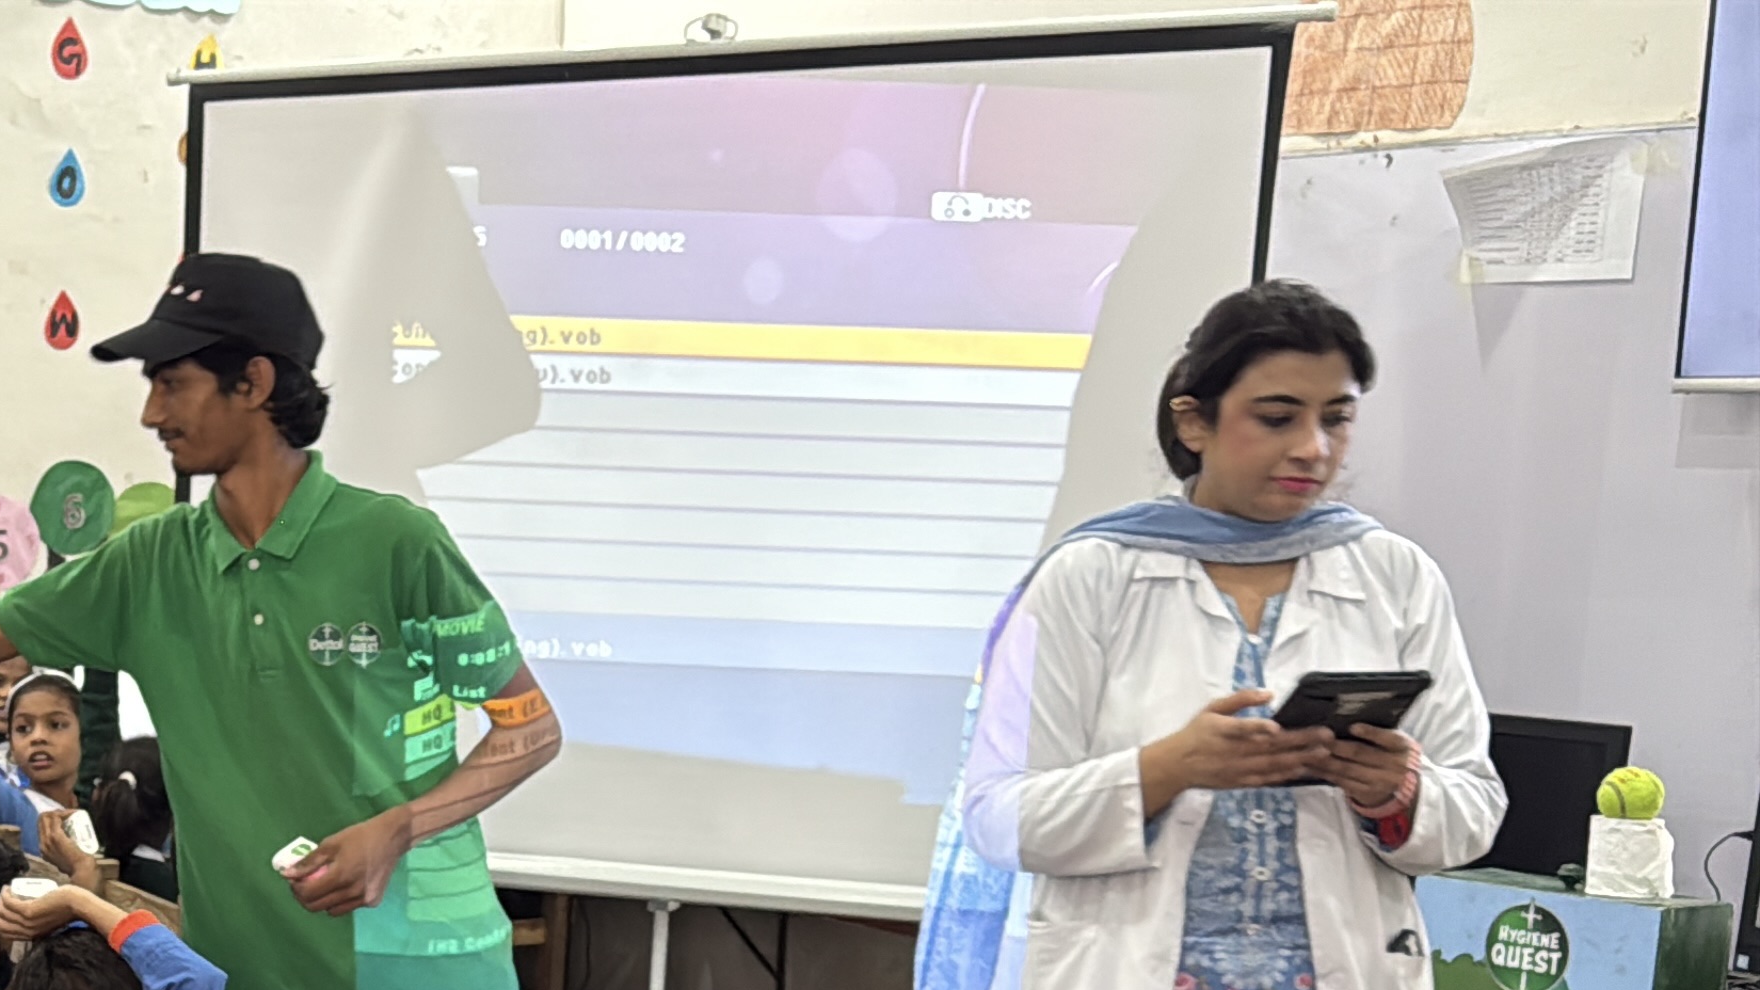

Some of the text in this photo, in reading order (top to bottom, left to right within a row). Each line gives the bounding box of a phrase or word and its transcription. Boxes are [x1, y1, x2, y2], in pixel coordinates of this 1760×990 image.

[57, 37, 82, 76] G
[982, 196, 1032, 220] DISC
[559, 229, 686, 252] 0001/0002
[48, 309, 76, 341] W
[64, 493, 87, 529] 6
[1498, 924, 1561, 950] HYGIENE
[1490, 942, 1563, 976] QUEST
